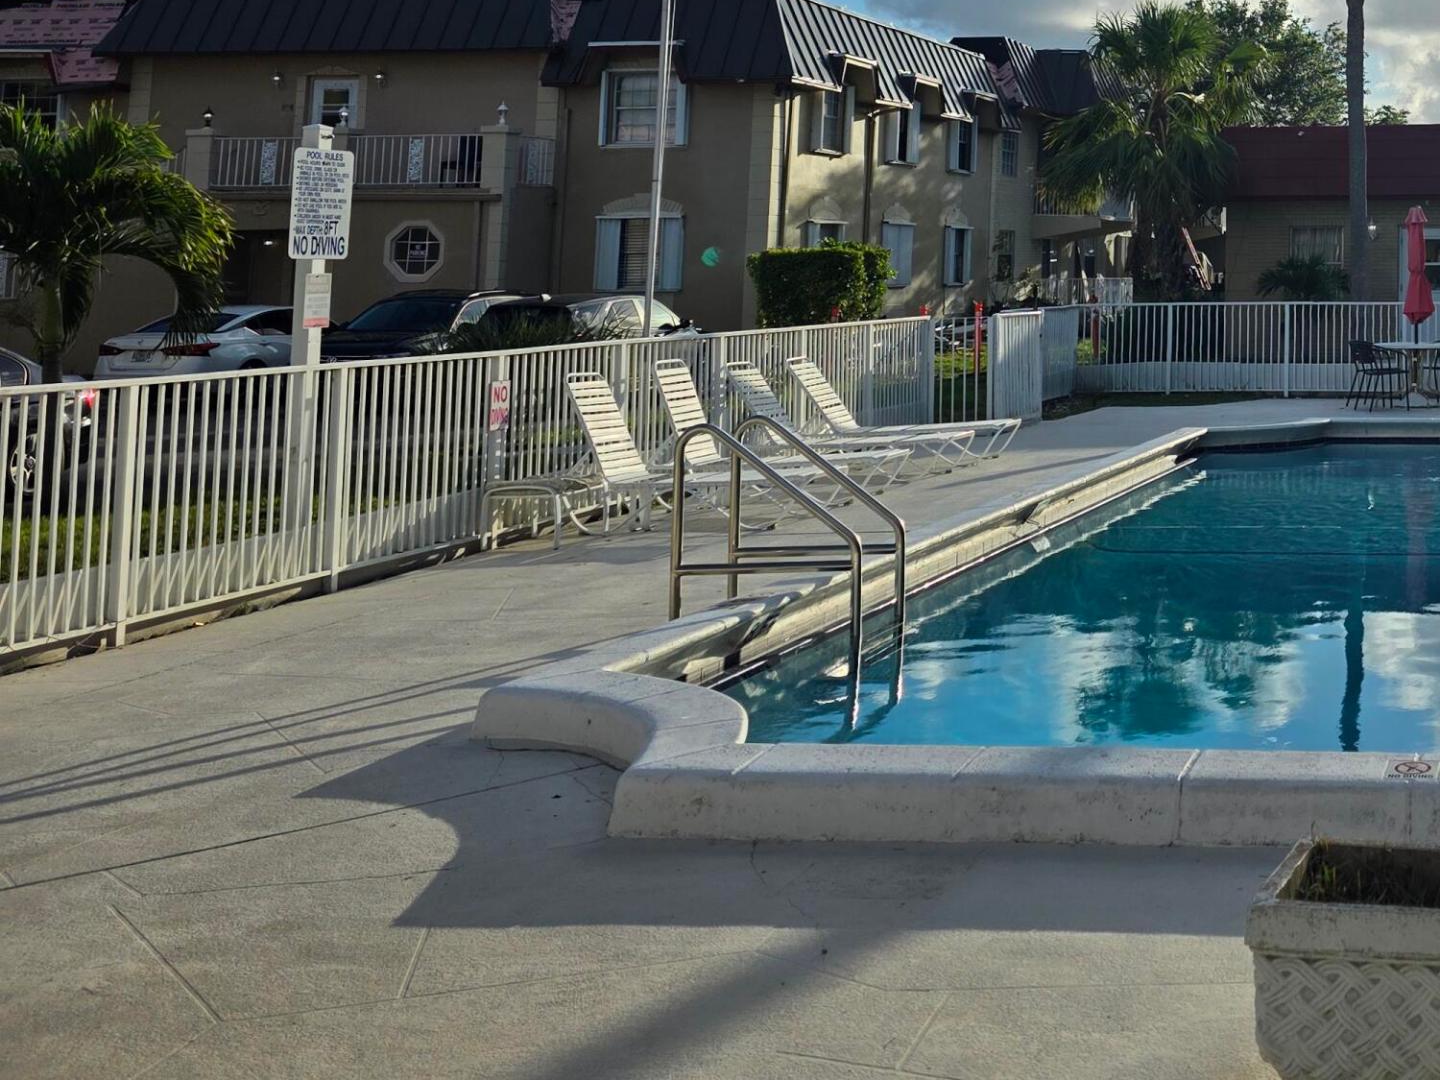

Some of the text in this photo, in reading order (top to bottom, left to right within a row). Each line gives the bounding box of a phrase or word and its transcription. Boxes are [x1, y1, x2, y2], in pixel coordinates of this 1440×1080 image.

[306, 151, 344, 161] POOL RULES
[324, 220, 339, 235] 8FT
[293, 235, 345, 255] NO DIVING
[494, 385, 508, 403] NO
